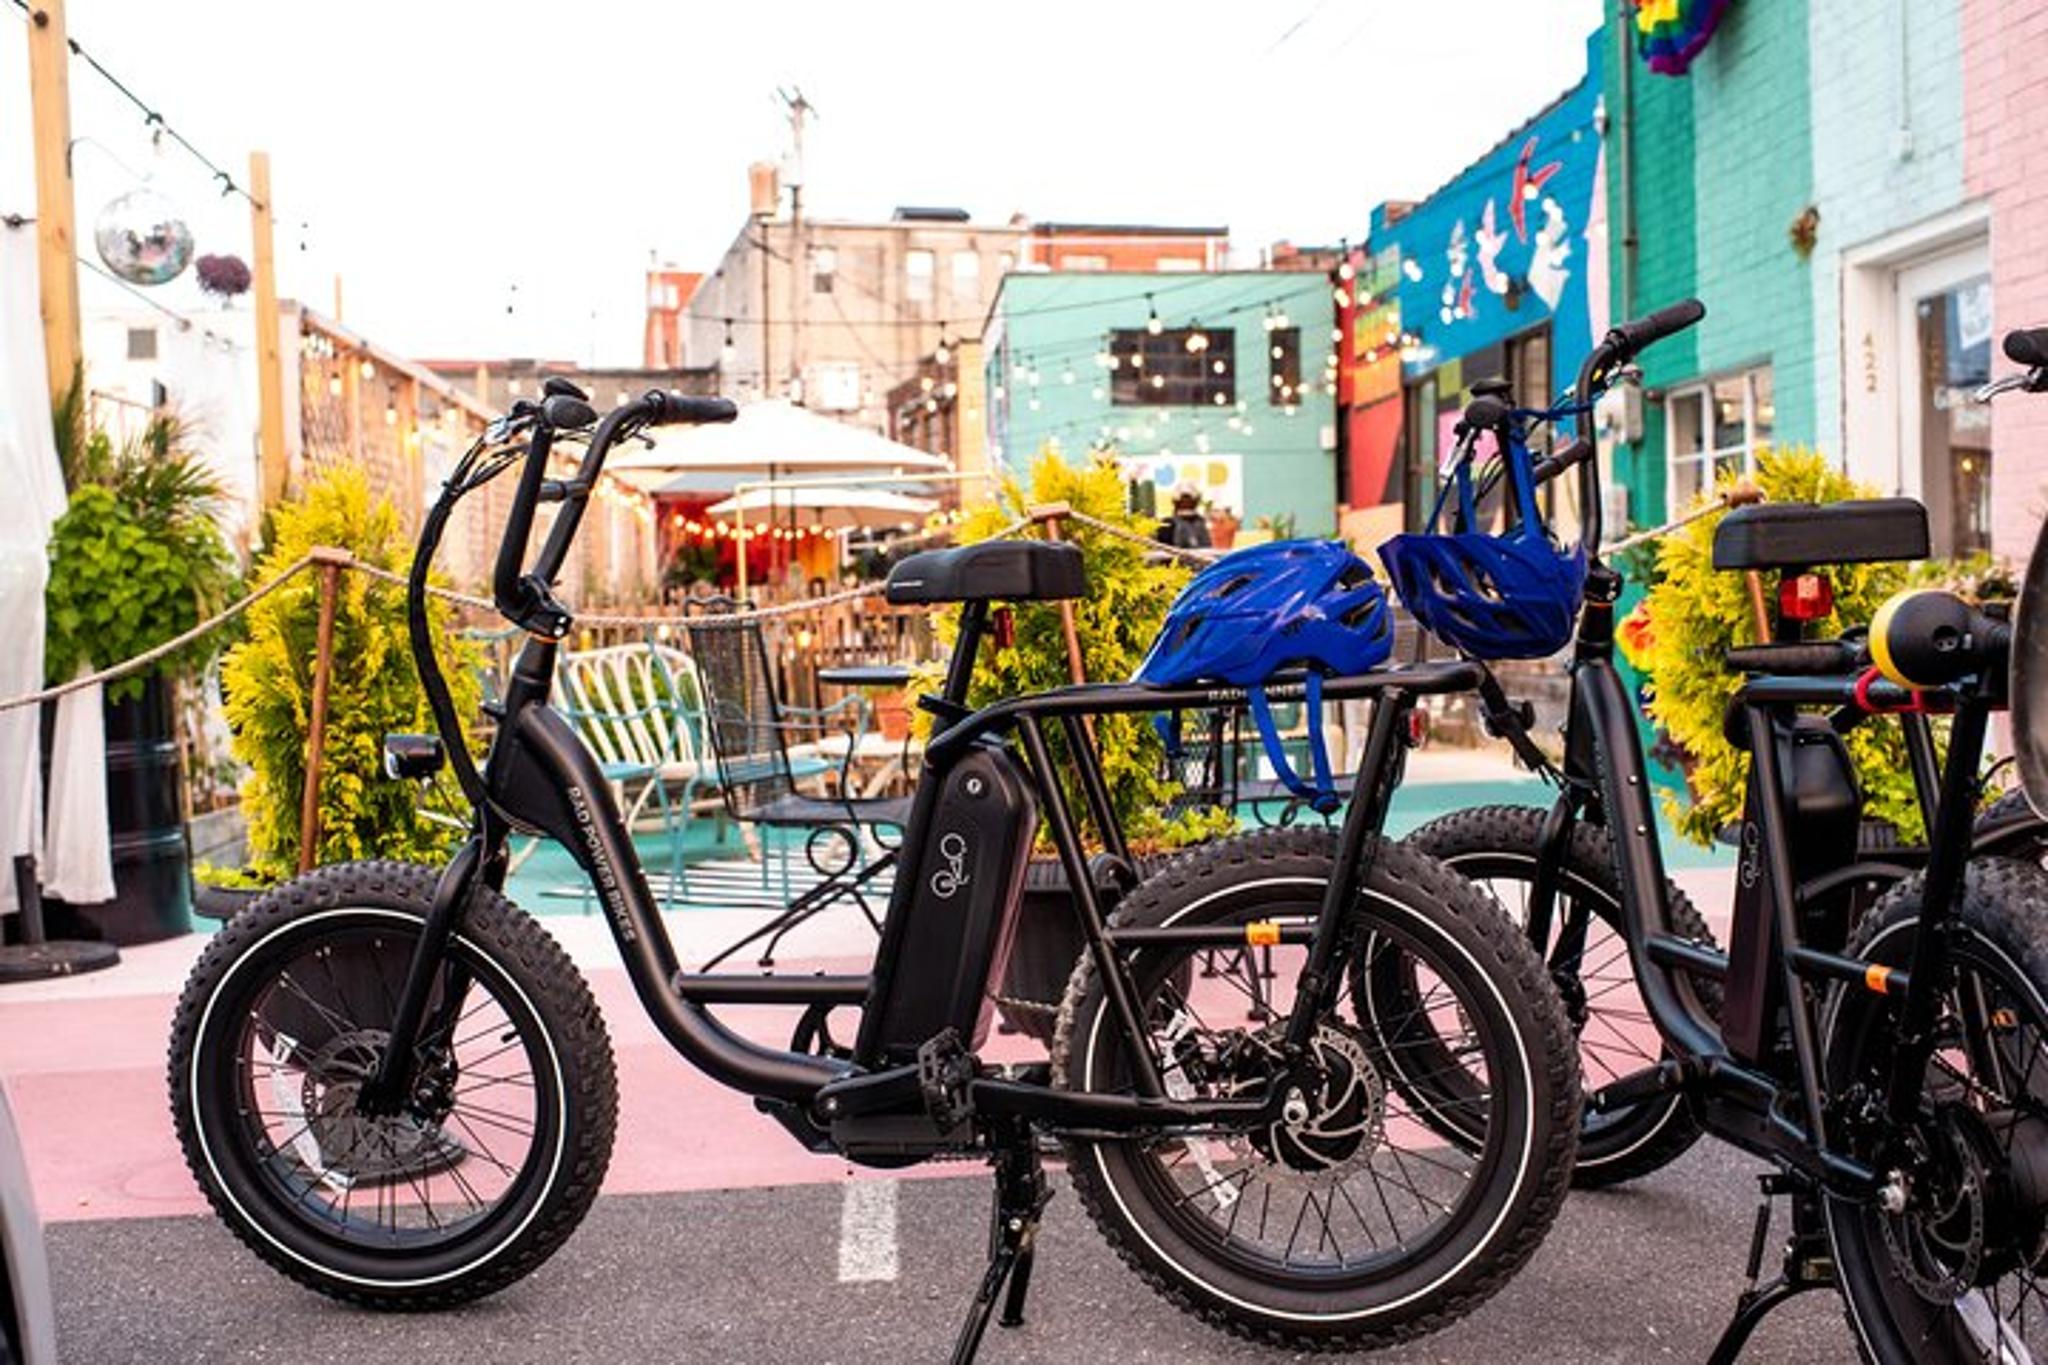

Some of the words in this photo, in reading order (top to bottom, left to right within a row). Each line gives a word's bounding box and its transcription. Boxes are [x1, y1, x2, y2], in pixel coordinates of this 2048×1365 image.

[1862, 332, 1877, 393] 422
[567, 786, 590, 823] RAD
[581, 825, 615, 890] POWER
[607, 889, 636, 942] BIKES
